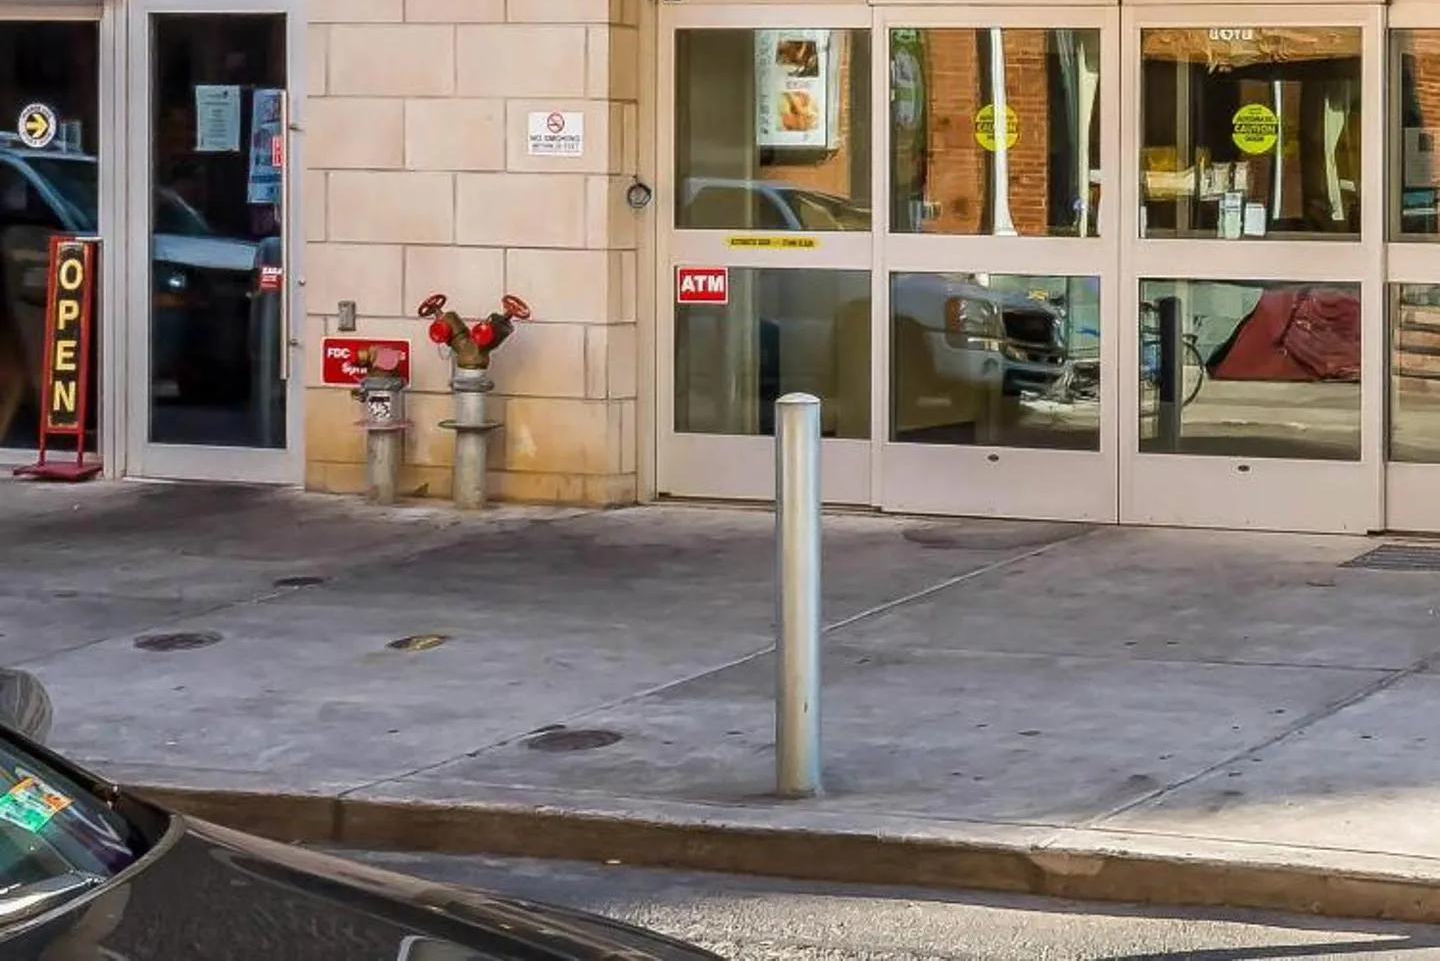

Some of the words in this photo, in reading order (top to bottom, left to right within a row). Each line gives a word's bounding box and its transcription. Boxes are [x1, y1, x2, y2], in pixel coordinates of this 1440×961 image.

[1234, 124, 1277, 135] CAUTION
[681, 275, 725, 293] ATM
[53, 258, 83, 413] OPEN
